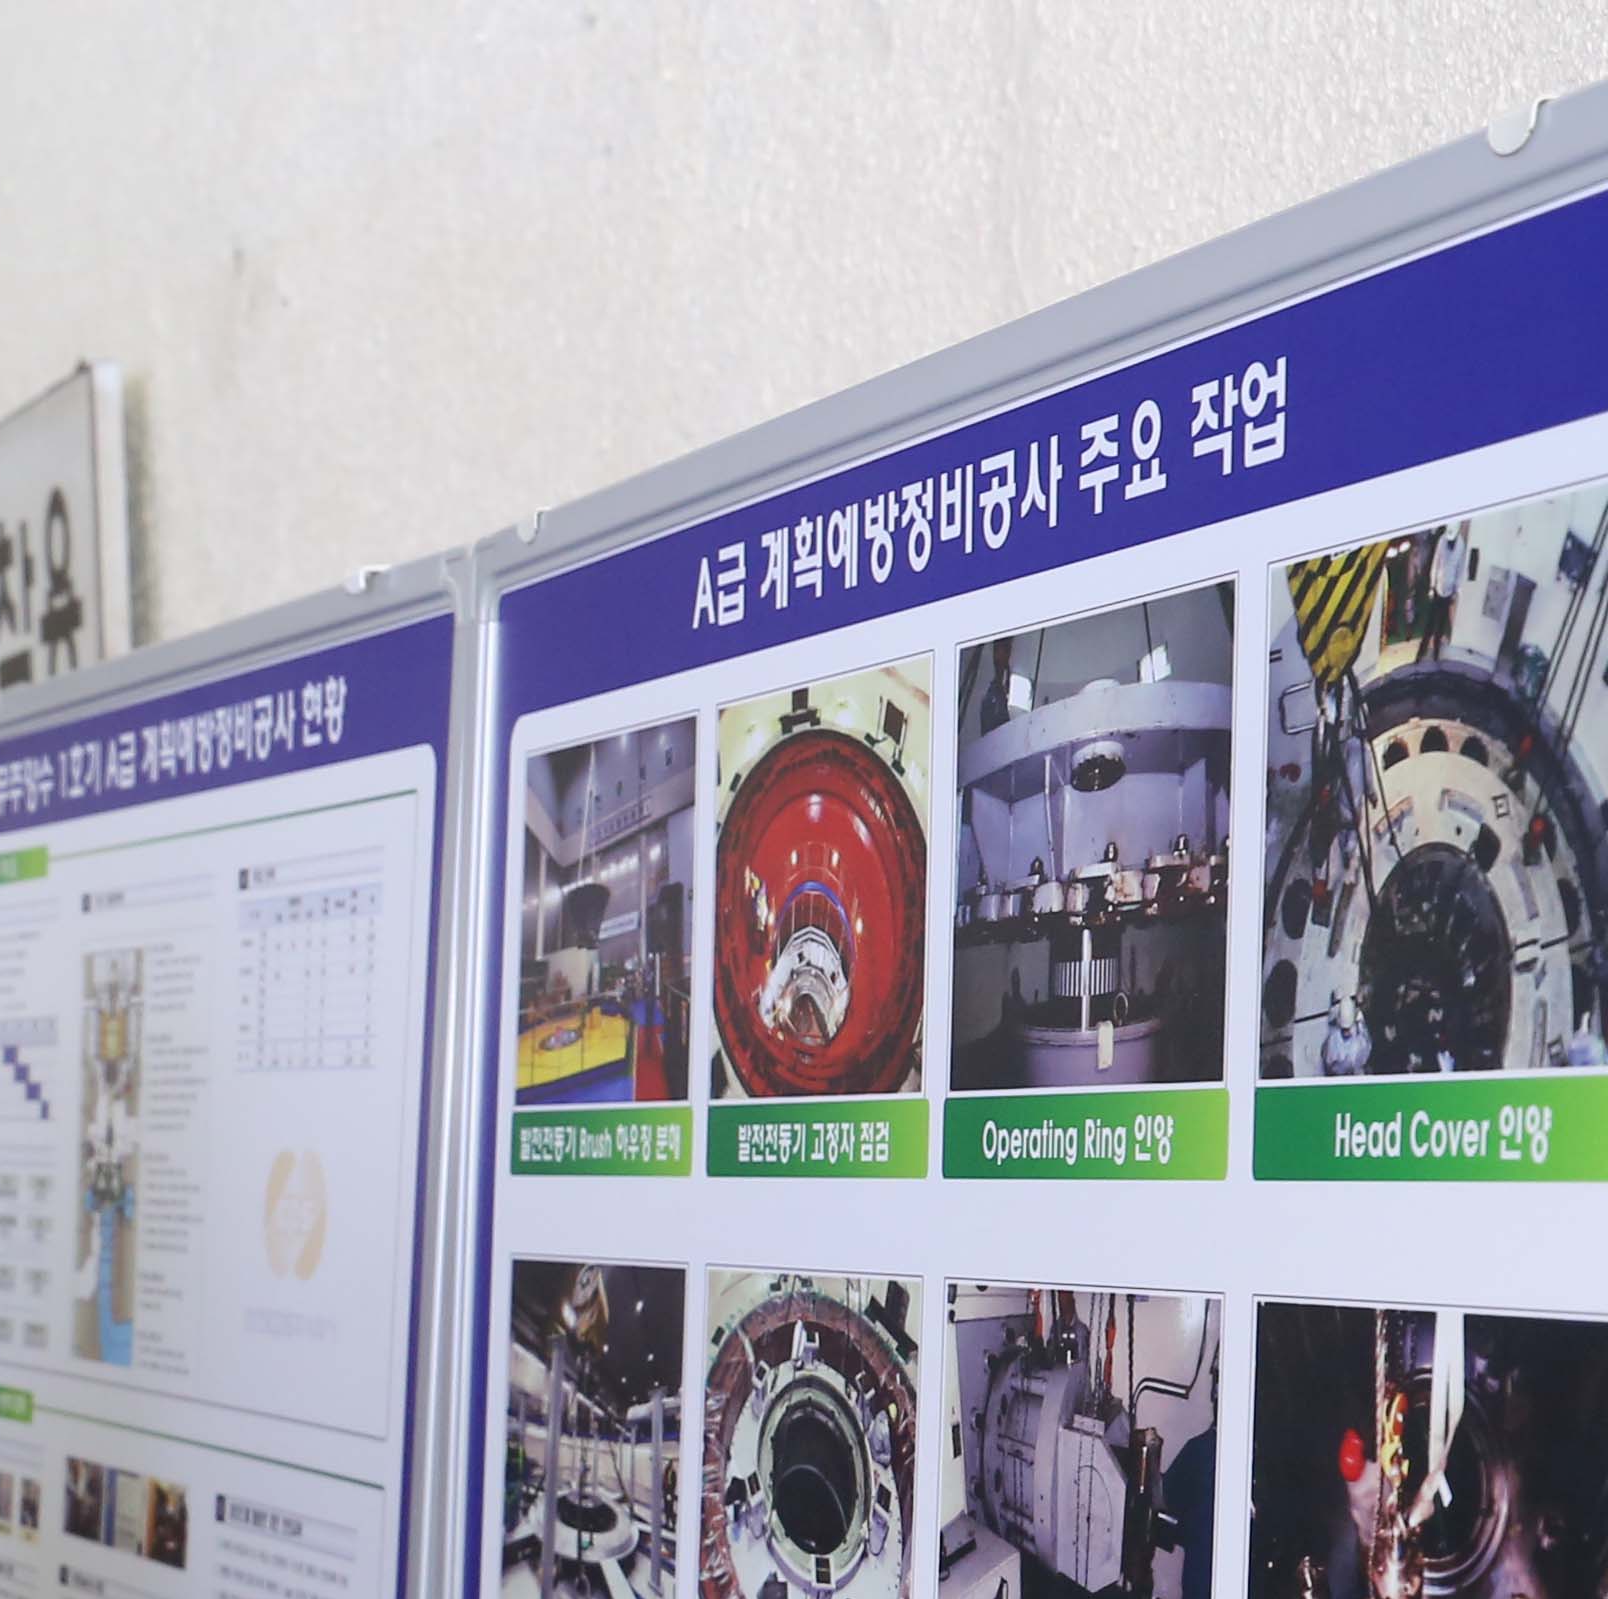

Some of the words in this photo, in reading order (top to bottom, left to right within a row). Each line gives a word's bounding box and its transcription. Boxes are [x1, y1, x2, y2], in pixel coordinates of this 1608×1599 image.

[693, 541, 747, 629] A급
[761, 435, 1063, 609] 계획예방정비공사
[1079, 399, 1167, 515] 주요
[1192, 357, 1287, 476] 작업
[59, 740, 102, 799] 1호기
[142, 690, 296, 784] 계획예방정비공사
[302, 675, 348, 747] 현황
[579, 1127, 612, 1159] Brush
[738, 1122, 806, 1164] 발전전동기
[811, 1121, 855, 1164] 고정자
[860, 1119, 890, 1164] 점검
[982, 1115, 1079, 1167] Operating
[1084, 1117, 1127, 1165] Ring
[1134, 1113, 1174, 1165] 인양
[1334, 1110, 1401, 1158] Head
[1410, 1109, 1490, 1158] Cover
[1500, 1104, 1552, 1165] 인양
